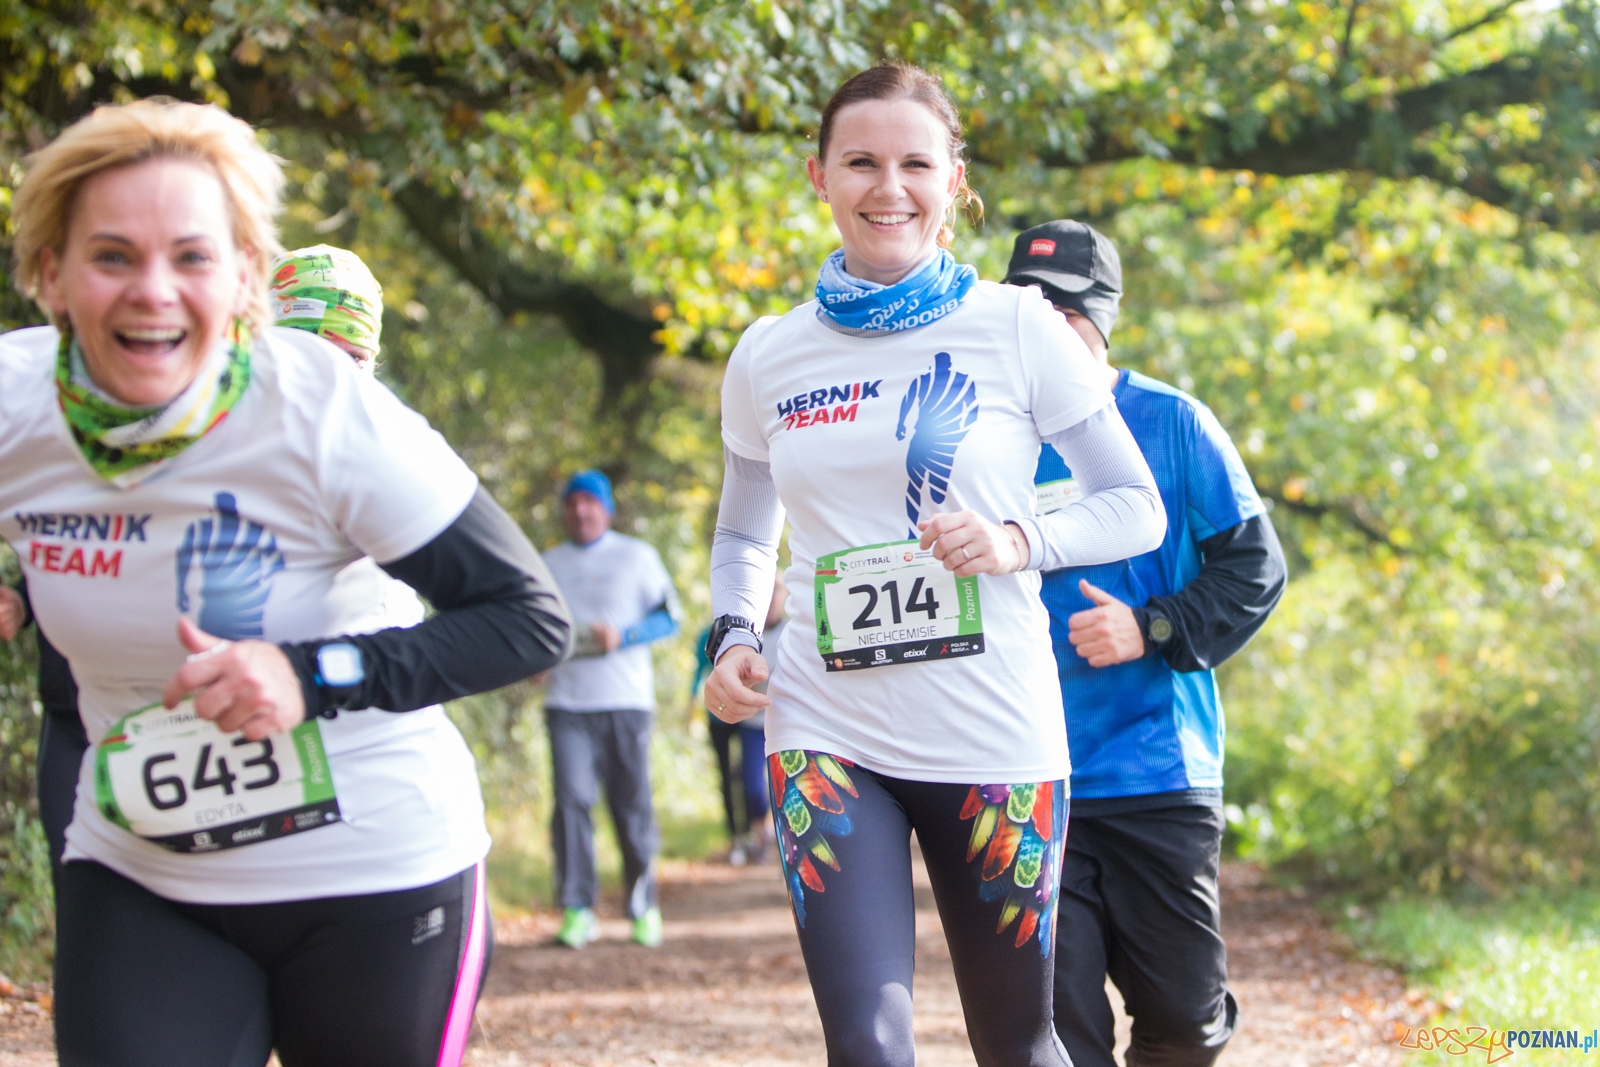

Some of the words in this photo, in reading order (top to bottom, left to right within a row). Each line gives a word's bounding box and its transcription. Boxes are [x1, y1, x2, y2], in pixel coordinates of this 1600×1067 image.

[1031, 243, 1053, 252] TORO
[777, 379, 884, 420] HERNIK
[783, 403, 859, 431] TEAM
[14, 511, 152, 542] HERNIK
[30, 540, 123, 577] TEAM
[848, 576, 940, 631] 214
[962, 581, 976, 621] Poznań
[858, 625, 938, 646] NIECHCEMISIE
[142, 735, 280, 811] 643
[194, 803, 248, 826] EDYTA
